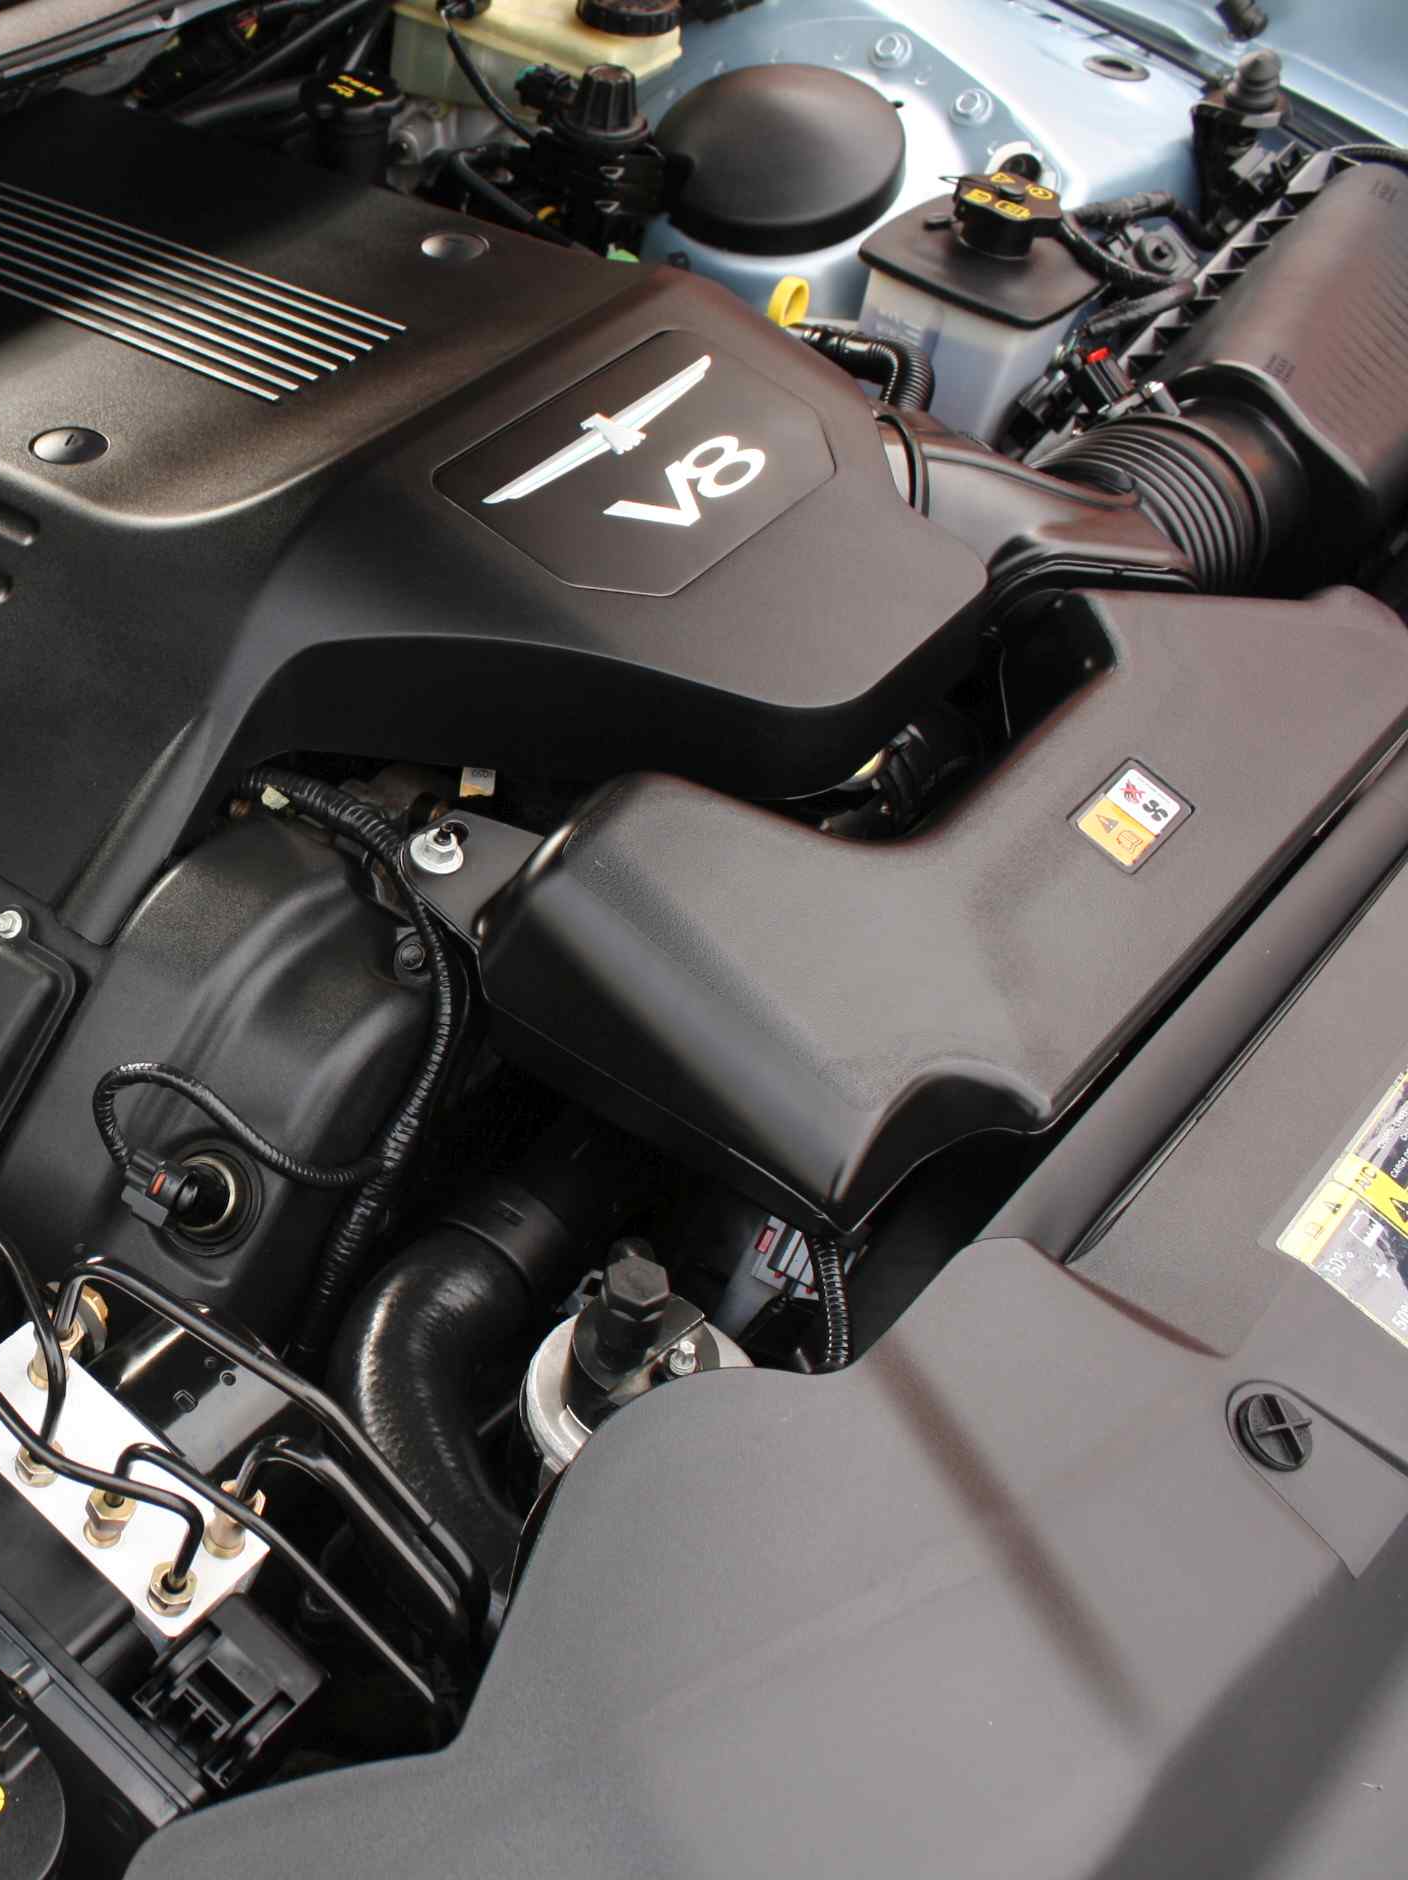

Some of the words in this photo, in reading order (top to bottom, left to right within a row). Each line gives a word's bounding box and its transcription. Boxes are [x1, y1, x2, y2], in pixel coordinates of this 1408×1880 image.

[603, 434, 766, 527] V8
[1354, 1166, 1378, 1192] A/C
[1326, 1251, 1355, 1277] 50%
